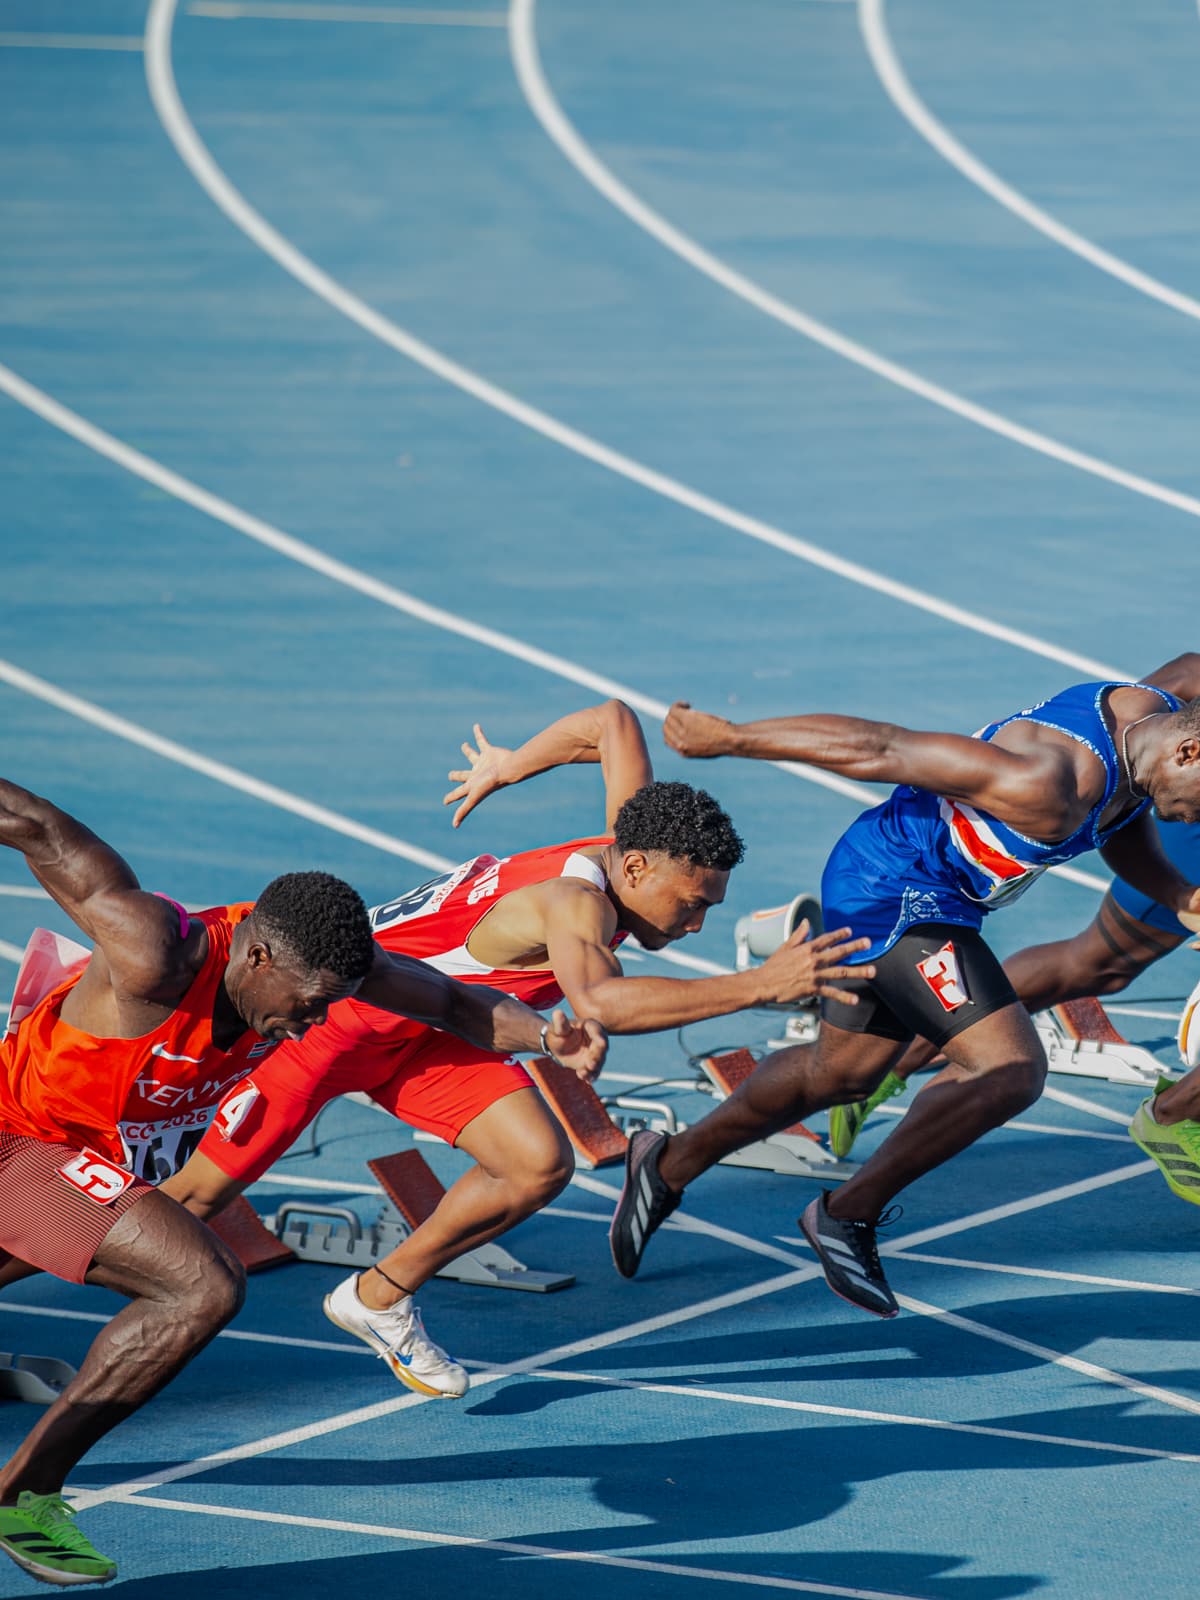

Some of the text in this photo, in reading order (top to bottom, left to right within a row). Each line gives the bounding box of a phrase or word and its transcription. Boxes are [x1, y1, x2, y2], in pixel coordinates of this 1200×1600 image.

[923, 951, 967, 1004] 3
[161, 1110, 208, 1130] 2026
[221, 1088, 257, 1136] 4
[62, 1155, 125, 1199] 5
